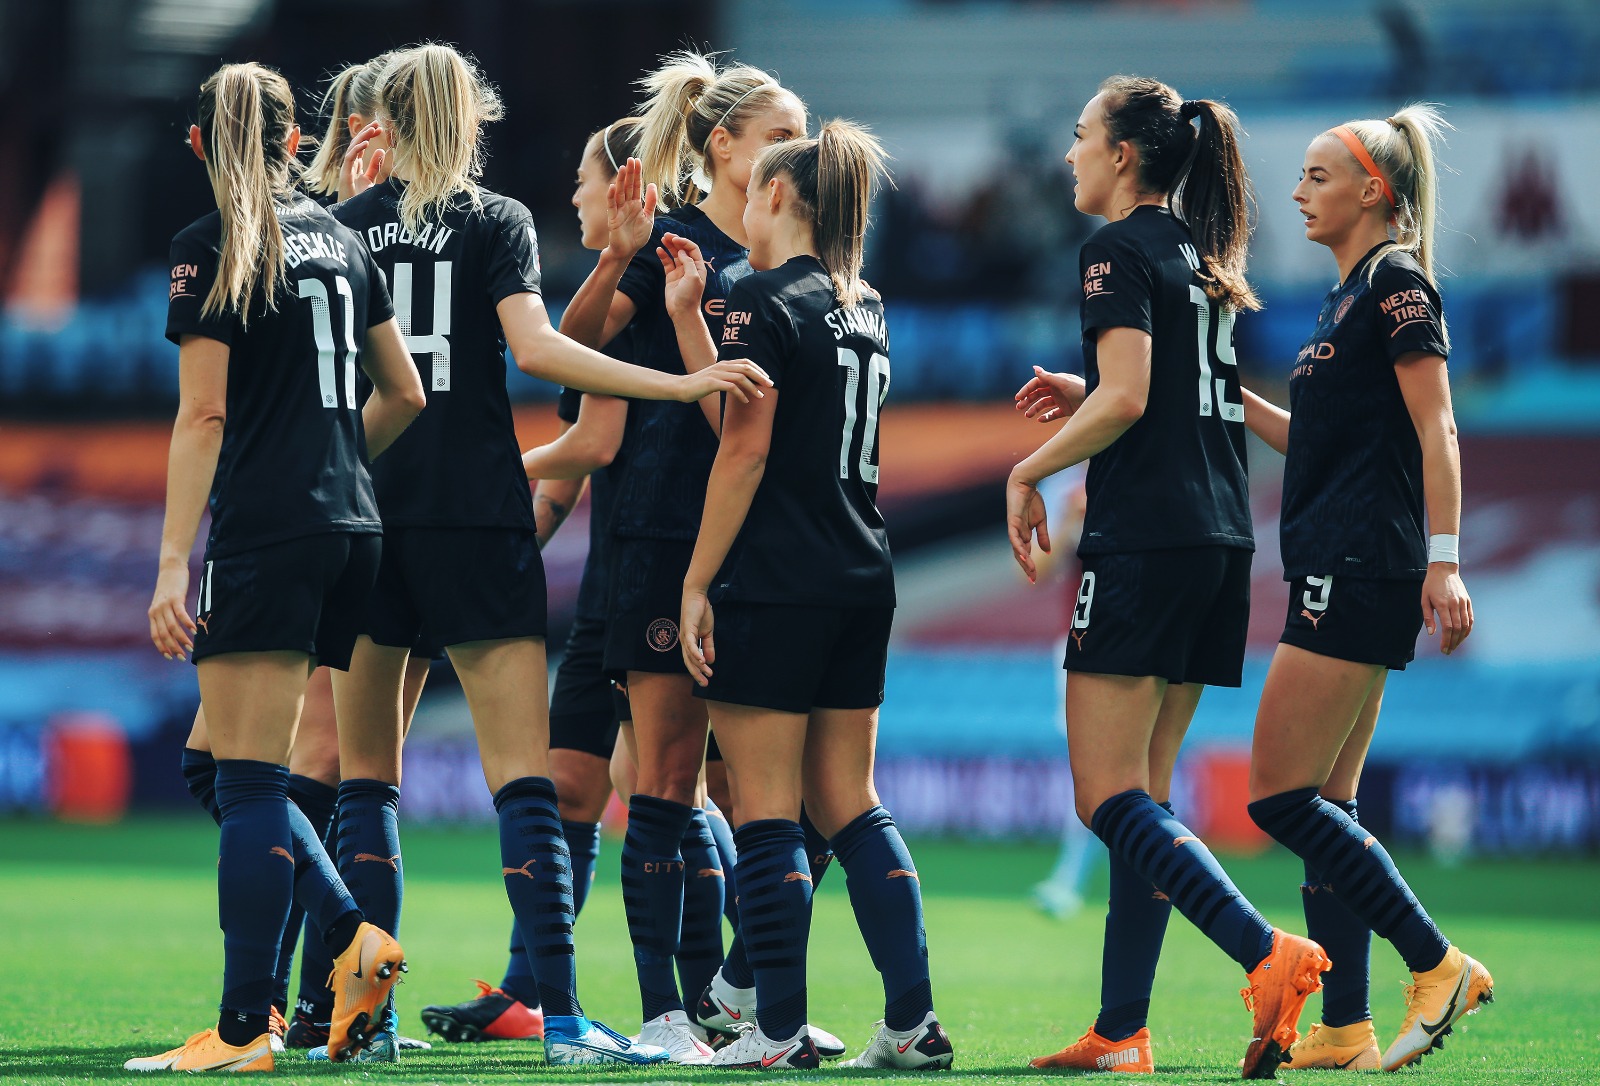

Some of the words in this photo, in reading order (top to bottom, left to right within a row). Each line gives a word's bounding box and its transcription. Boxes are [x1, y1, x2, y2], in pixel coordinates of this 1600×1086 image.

[282, 232, 348, 269] BECKIE
[360, 222, 453, 254] ORGAN
[169, 279, 187, 298] RE
[1379, 289, 1430, 315] NEXEN
[1390, 304, 1429, 323] TIRE
[298, 277, 356, 410] 11
[721, 325, 740, 341] RE
[1188, 284, 1245, 422] 19
[836, 347, 891, 485] 10
[643, 861, 686, 873] CITY
[1095, 1047, 1140, 1069] PUMA
